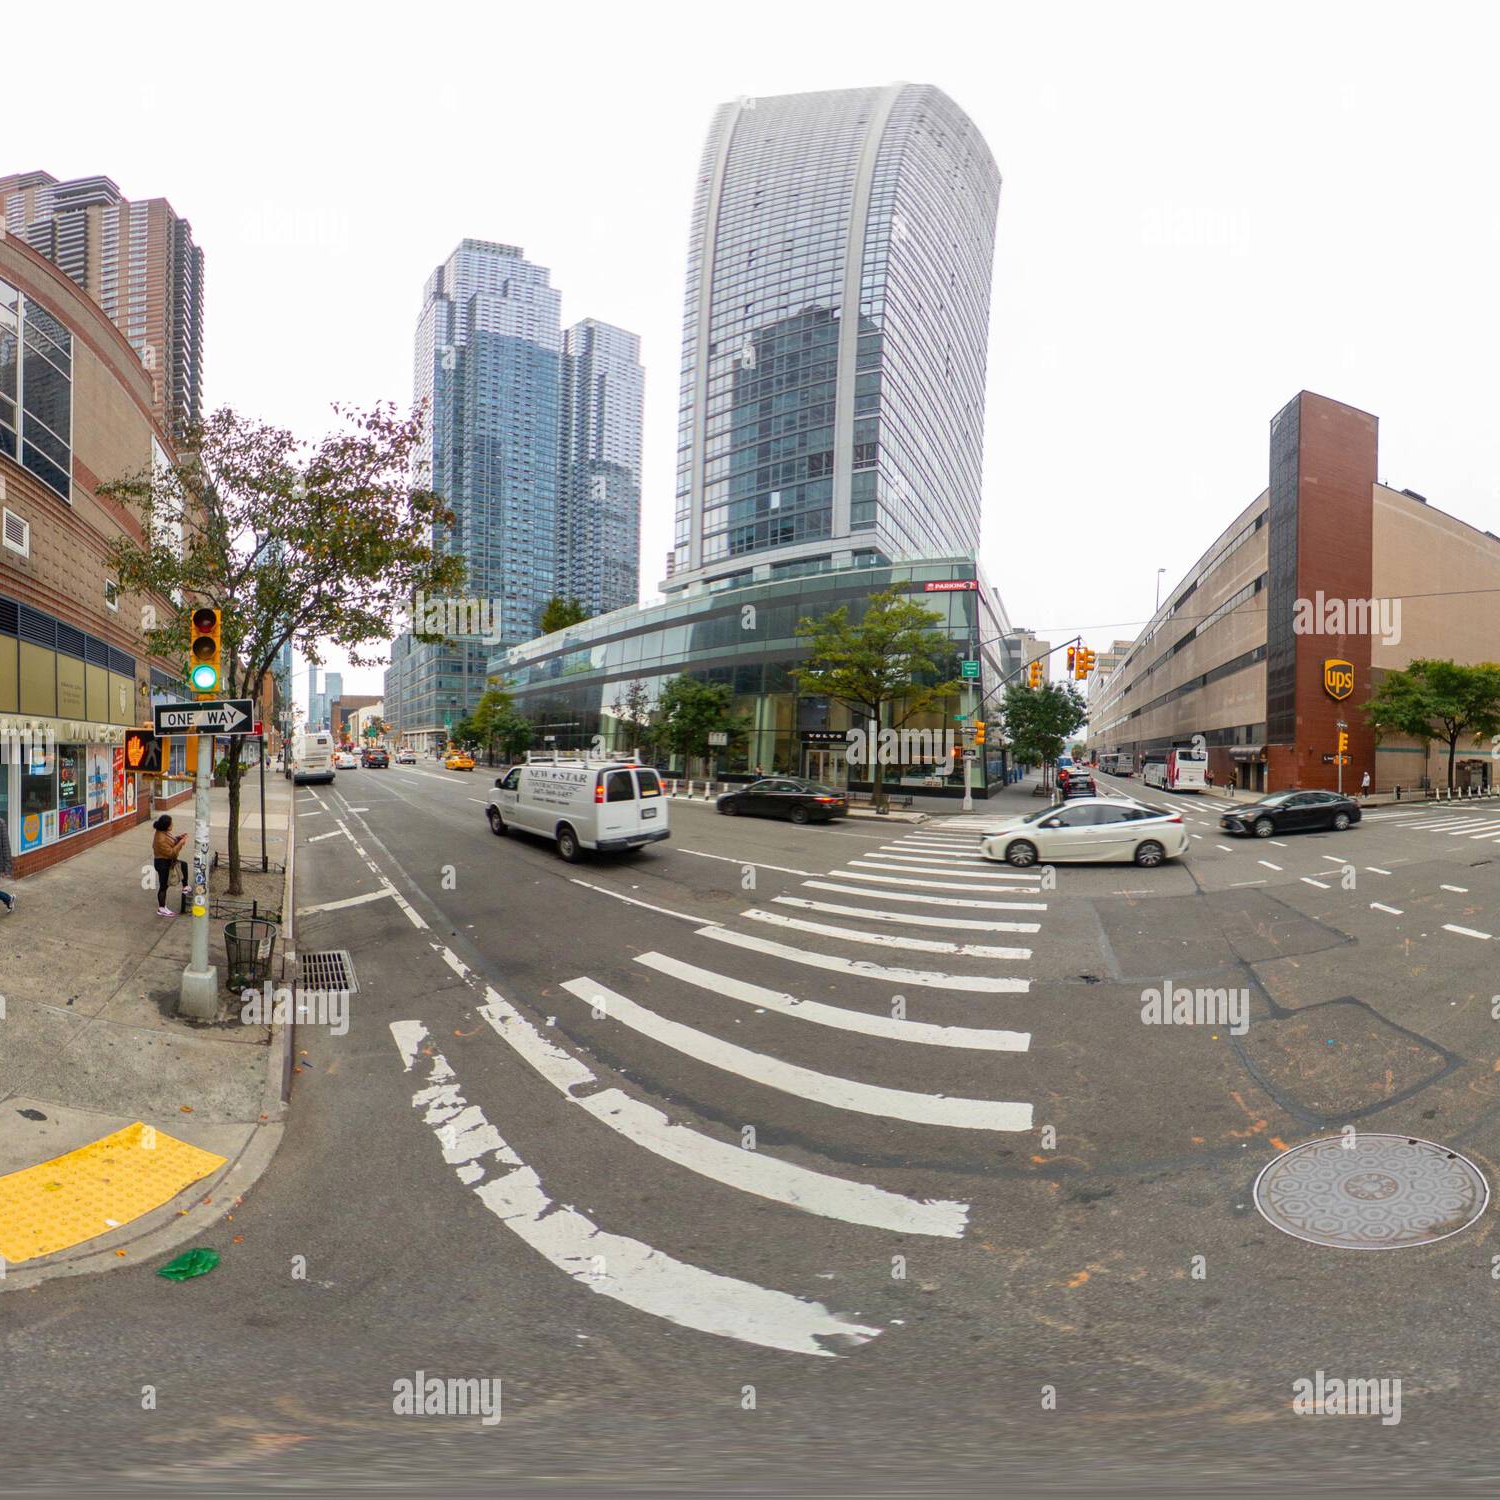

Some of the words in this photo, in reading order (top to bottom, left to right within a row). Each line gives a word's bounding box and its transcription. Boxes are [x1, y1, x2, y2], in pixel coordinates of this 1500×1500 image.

[1327, 670, 1352, 693] ups
[168, 713, 194, 725] ONE
[208, 711, 237, 723] WAY
[529, 770, 548, 778] NEW
[558, 772, 588, 783] STAR
